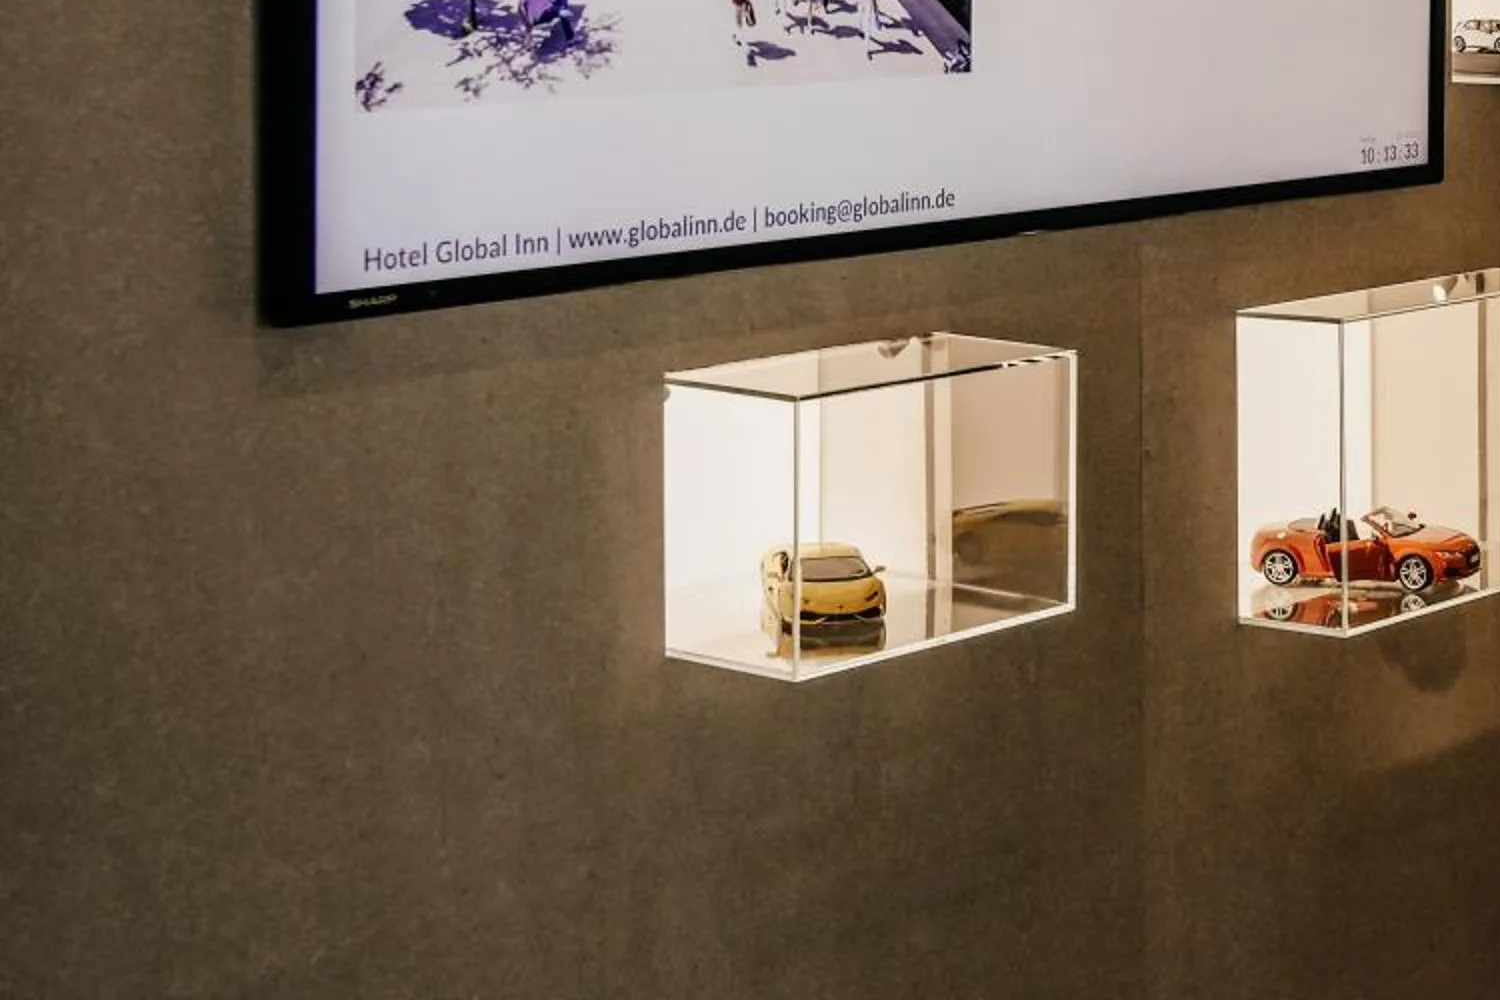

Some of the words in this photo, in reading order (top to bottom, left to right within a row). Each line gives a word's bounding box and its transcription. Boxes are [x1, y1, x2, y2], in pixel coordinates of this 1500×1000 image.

[364, 245, 427, 272] Hotel
[436, 237, 507, 264] Global
[516, 233, 548, 255] Inn
[568, 210, 747, 249] www.globalinn.de
[764, 189, 956, 229] booking@globalinn.de
